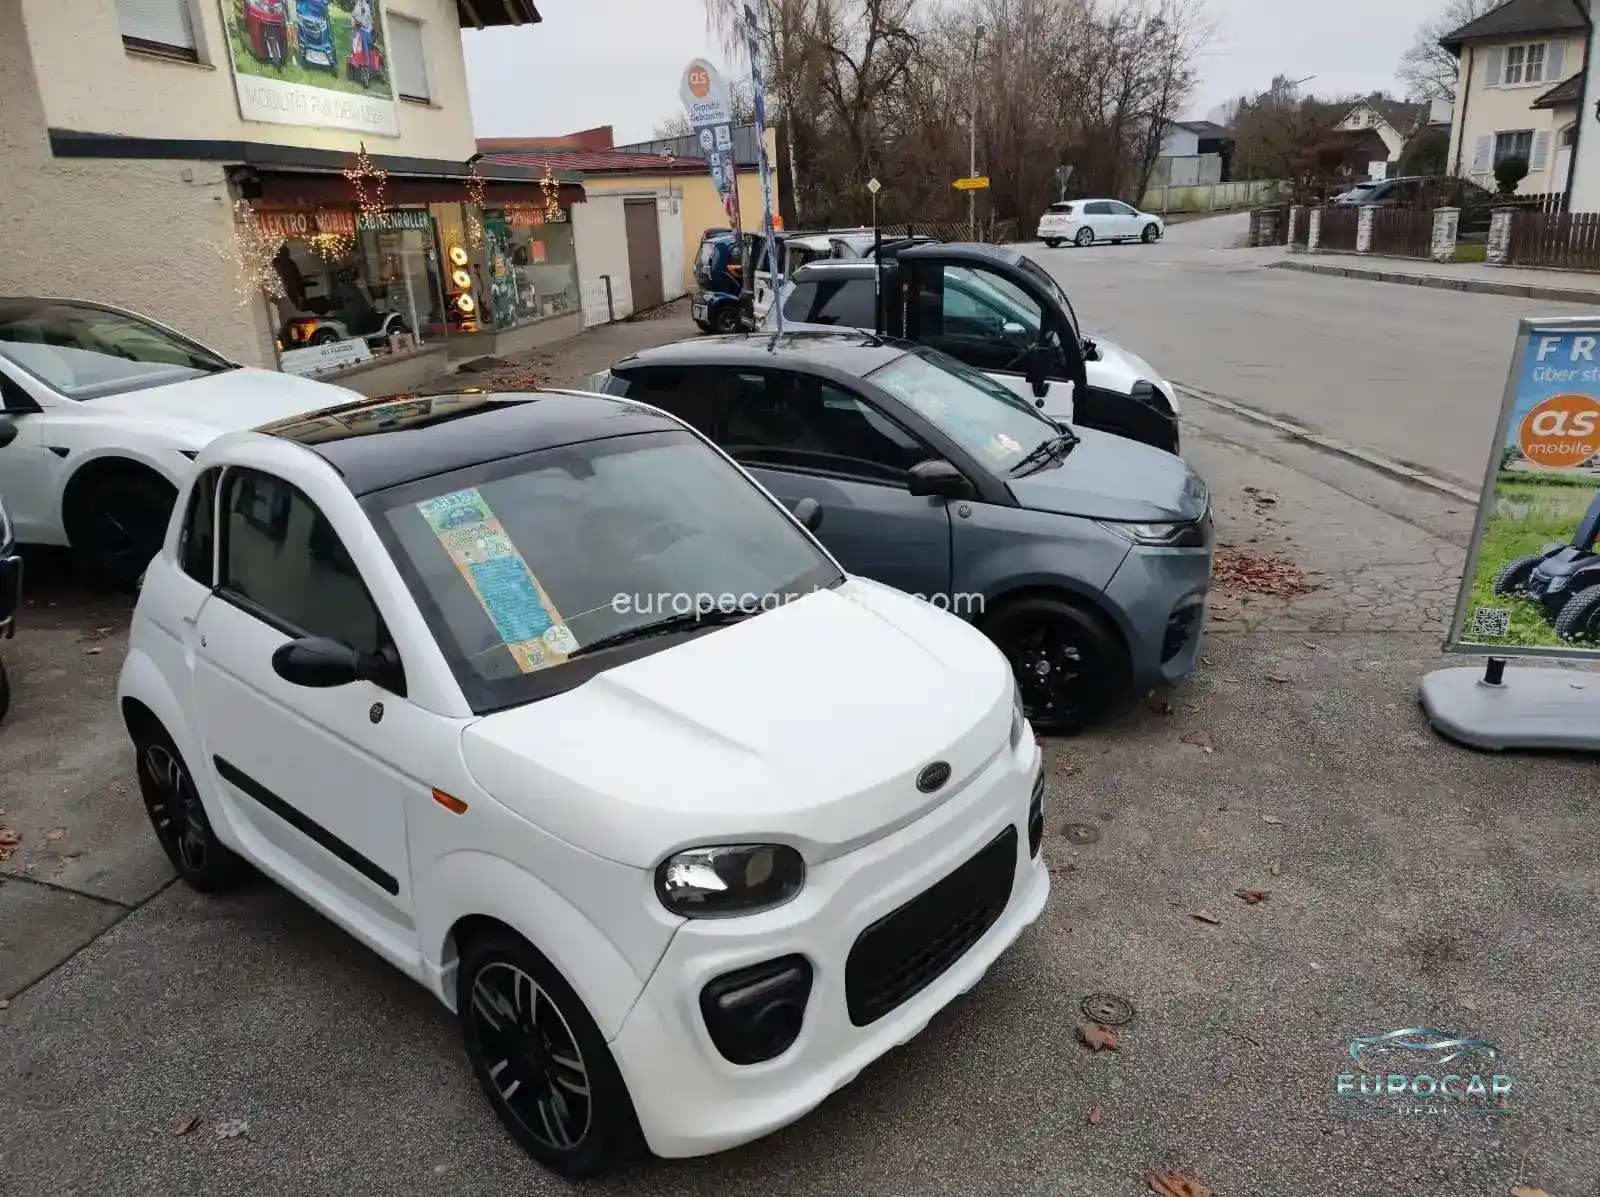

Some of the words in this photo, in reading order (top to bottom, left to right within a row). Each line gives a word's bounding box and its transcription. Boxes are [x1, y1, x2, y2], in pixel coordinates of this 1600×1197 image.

[315, 211, 353, 233] MOBILE
[1533, 366, 1578, 381] über
[1532, 409, 1600, 437] as
[1527, 441, 1593, 456] mobile
